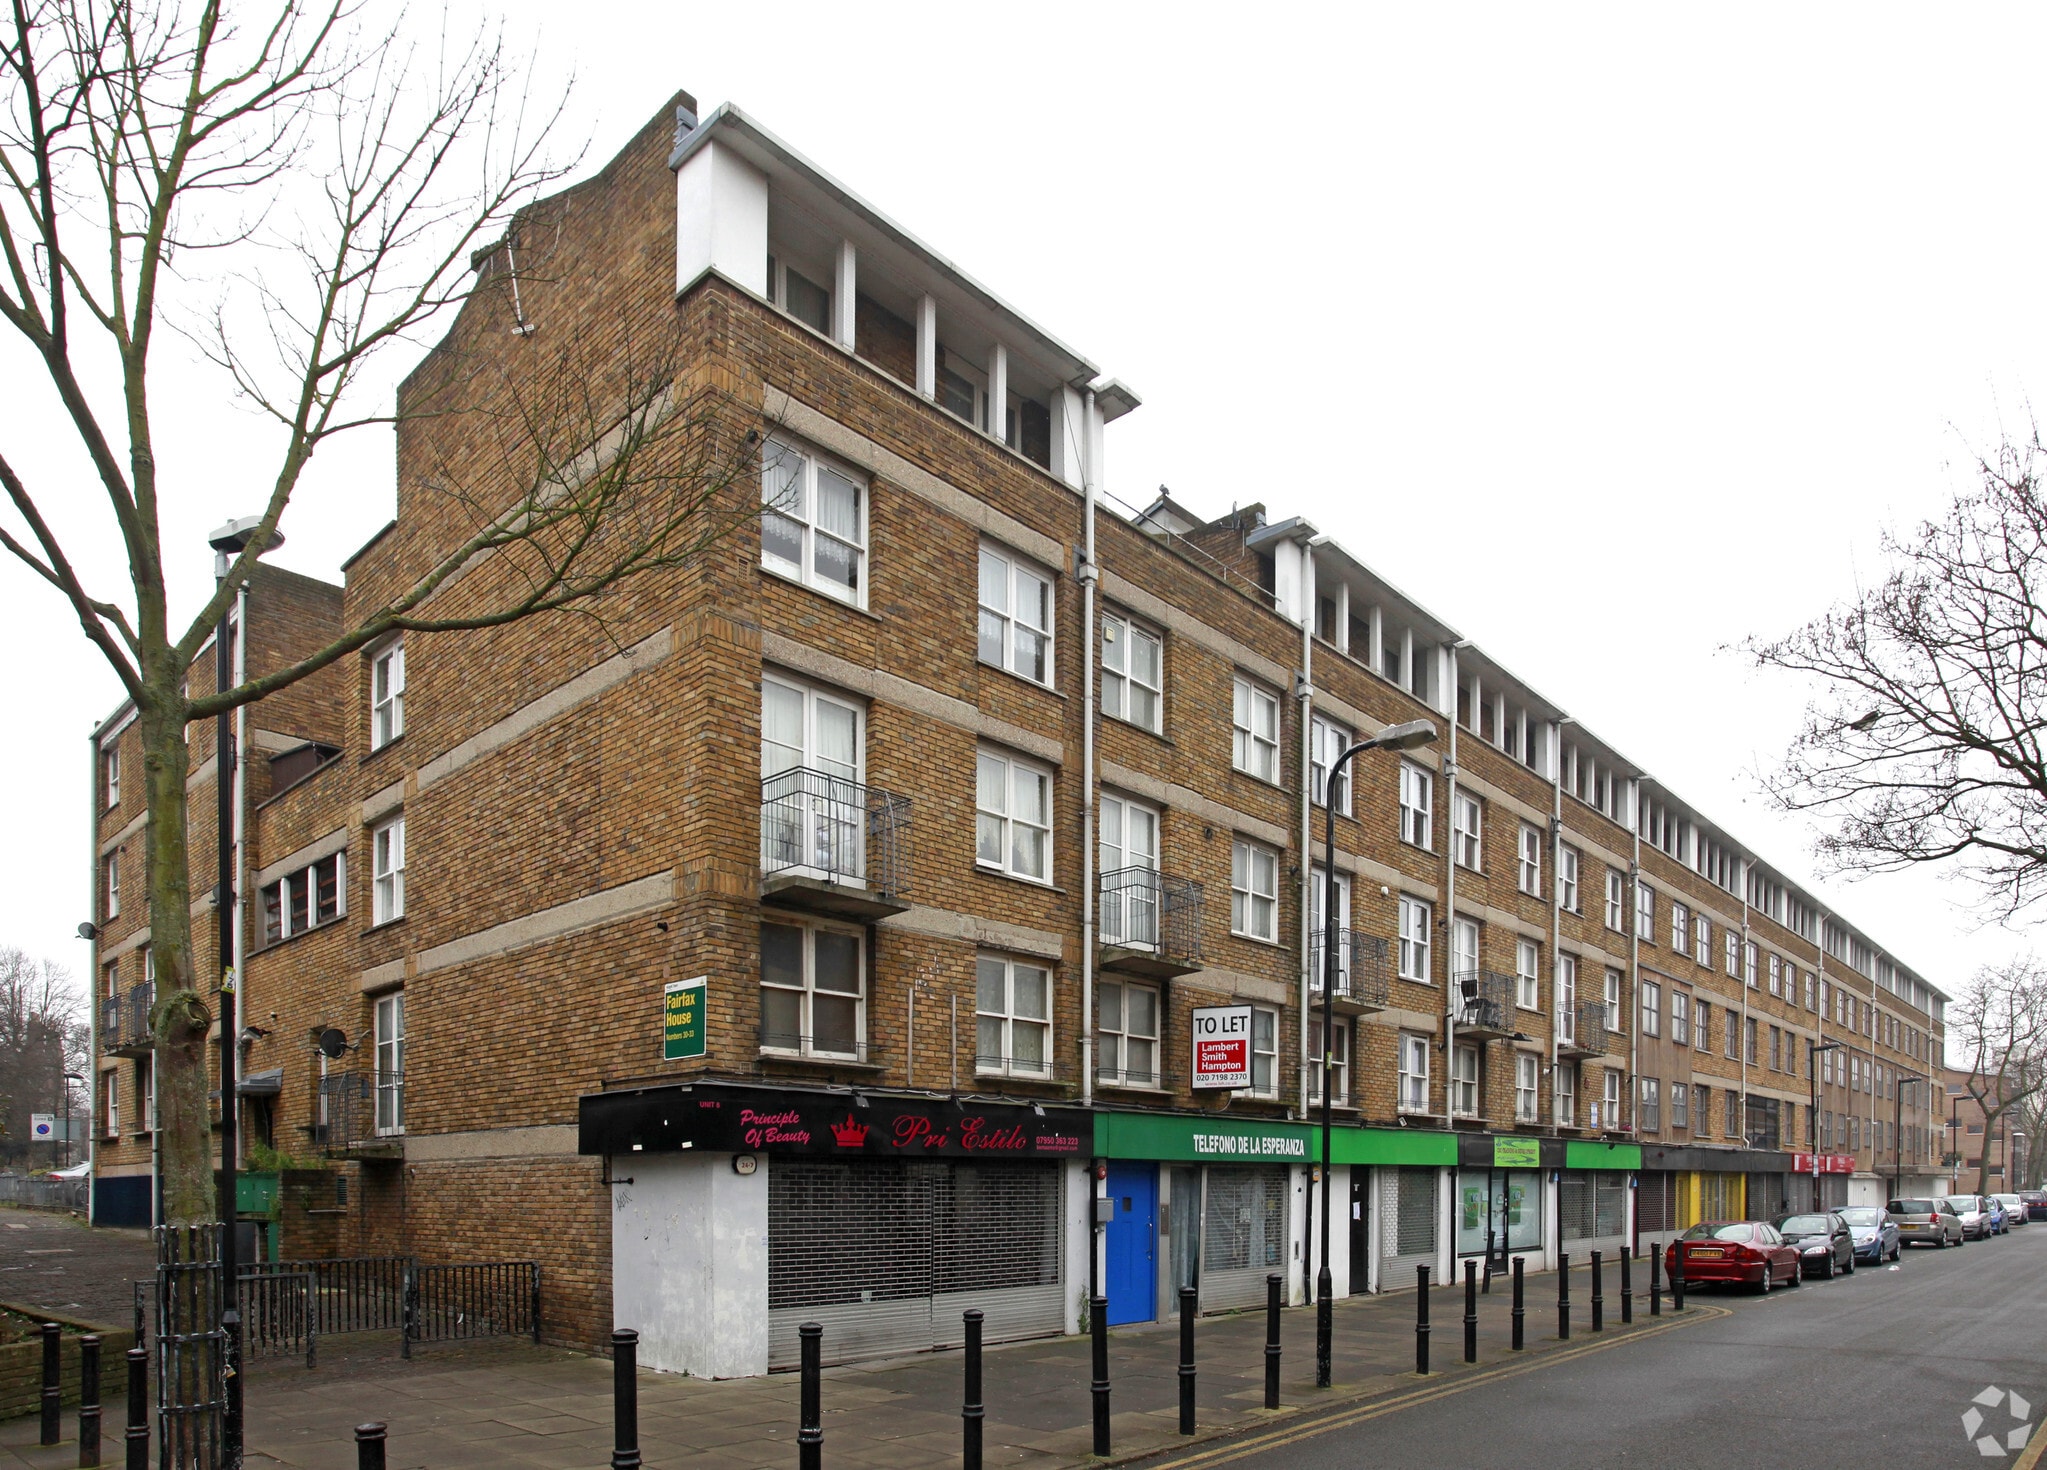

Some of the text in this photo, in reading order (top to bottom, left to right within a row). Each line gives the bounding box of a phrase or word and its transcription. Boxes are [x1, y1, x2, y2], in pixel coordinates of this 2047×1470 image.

[666, 992, 696, 1010] Fairfax
[666, 1011, 692, 1027] House
[1195, 1015, 1248, 1034] TO LET
[1201, 1042, 1239, 1052] Lambert
[1201, 1052, 1228, 1061] Smith
[1201, 1061, 1242, 1071] Hampton
[1196, 1074, 1210, 1082] 020
[1211, 1073, 1229, 1081] 7198
[740, 1109, 800, 1127] Principle
[745, 1127, 811, 1148] Of Beauty
[892, 1114, 1027, 1151] Pri Estilo
[1193, 1134, 1305, 1156] TELEFONO DE LA ESPERANZA
